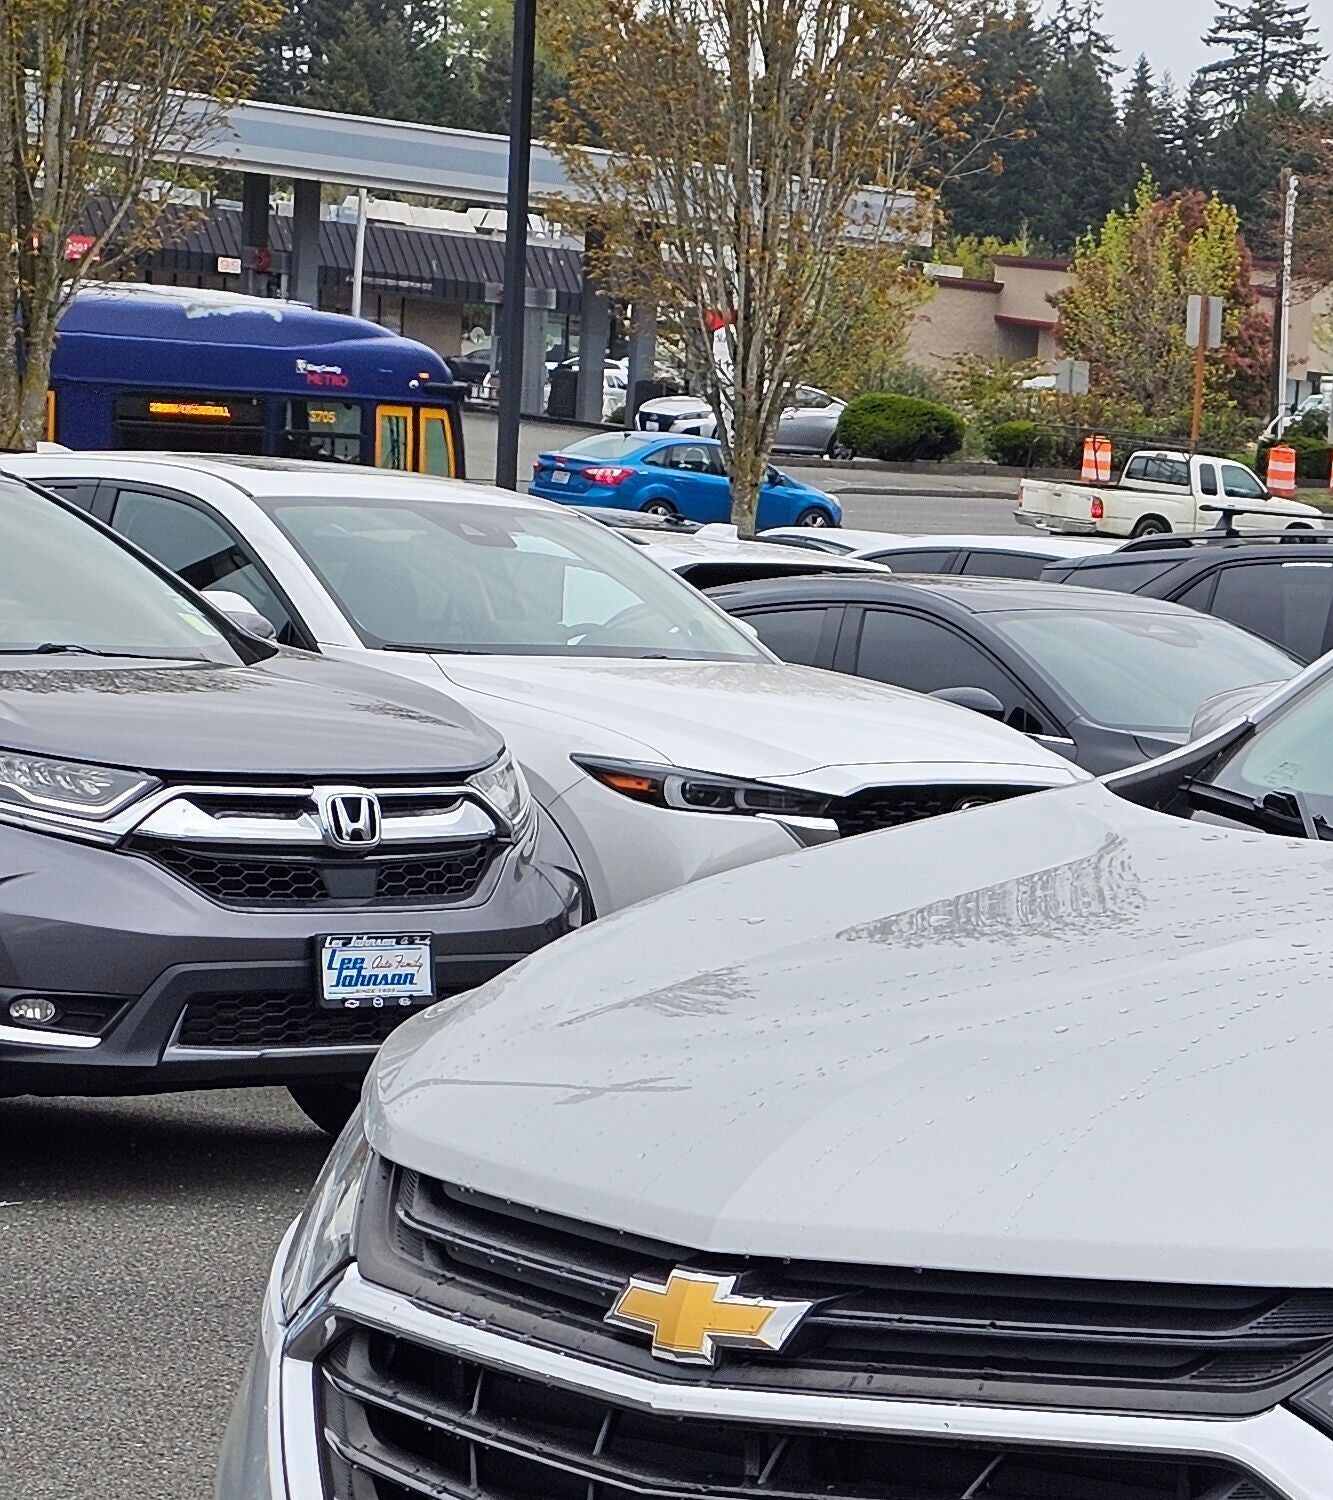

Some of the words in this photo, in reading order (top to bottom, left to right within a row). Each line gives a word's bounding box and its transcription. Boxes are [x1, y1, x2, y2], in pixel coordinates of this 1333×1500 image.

[307, 374, 349, 387] METRO
[327, 949, 368, 971] Lee
[329, 962, 418, 987] Johnson
